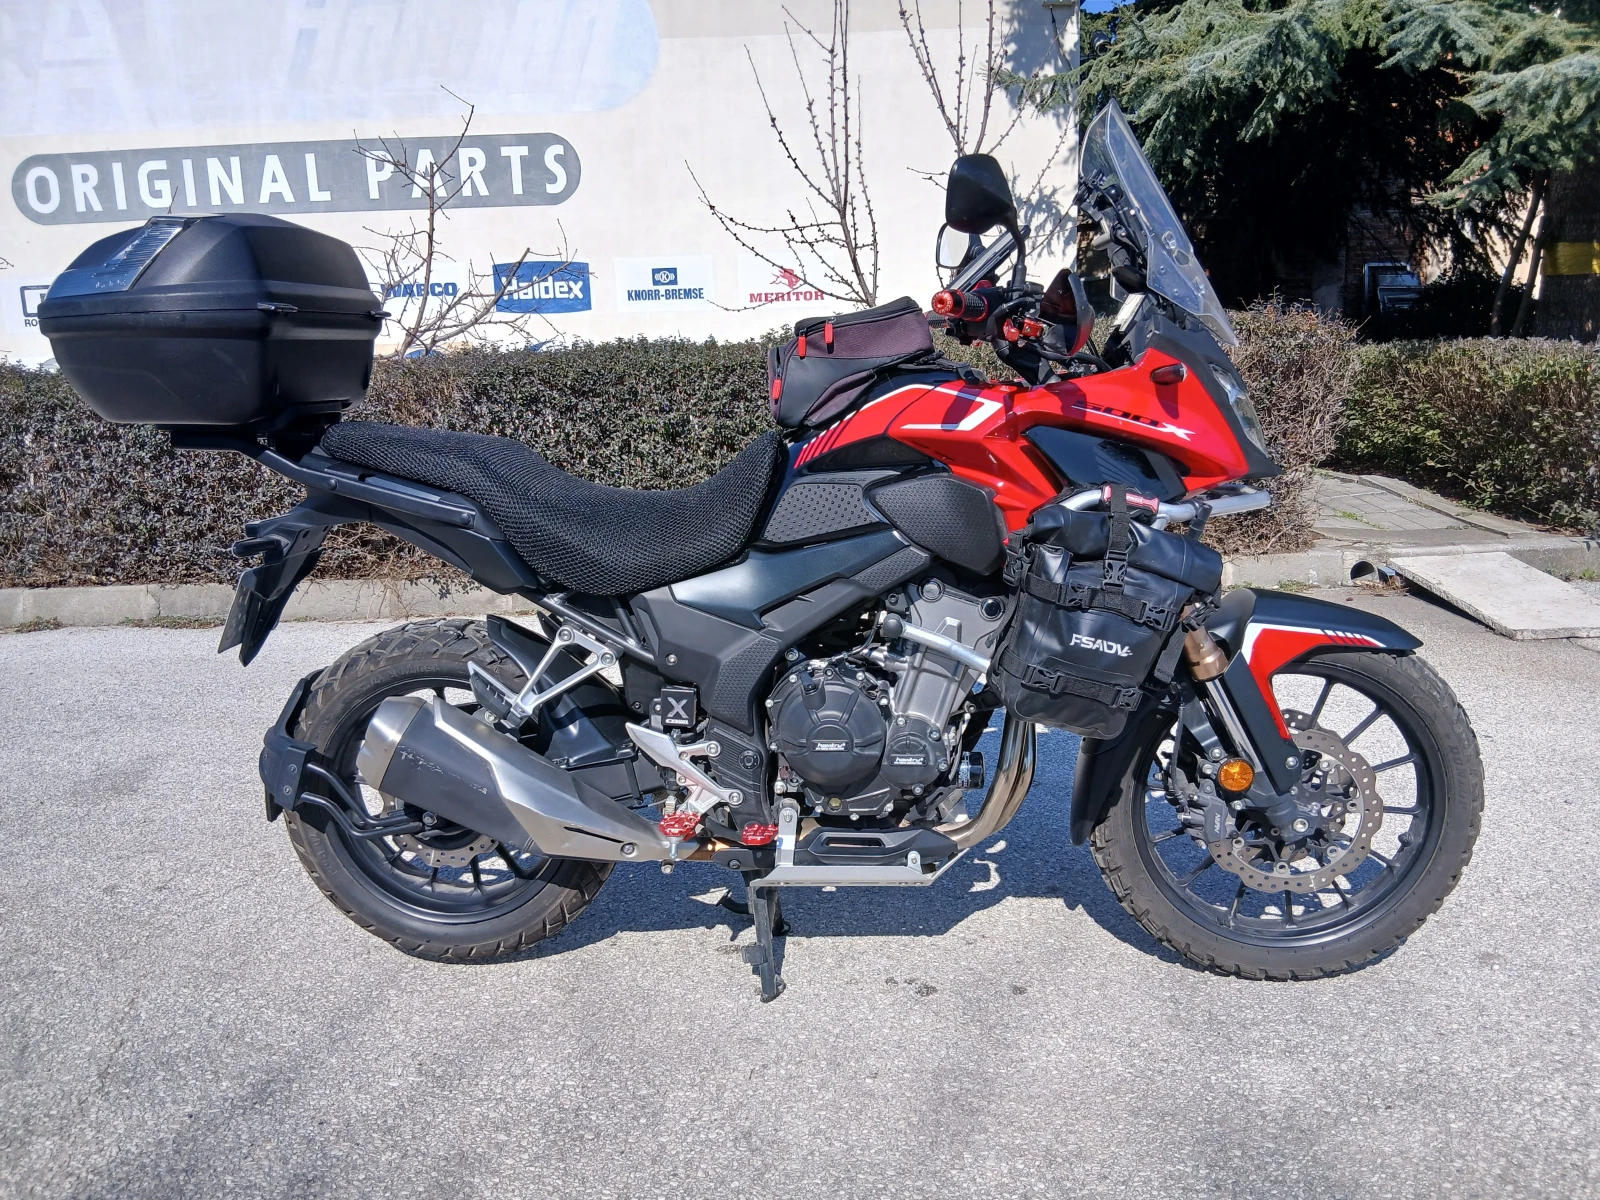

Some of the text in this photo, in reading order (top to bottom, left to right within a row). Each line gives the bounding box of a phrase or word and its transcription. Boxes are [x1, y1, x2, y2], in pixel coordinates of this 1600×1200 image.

[25, 144, 567, 214] ORIGINAL PARTS
[380, 282, 458, 298] WABCO
[501, 274, 584, 300] Haldex
[627, 287, 704, 302] KNORR-BREMSE
[749, 290, 825, 303] MERITOR
[1069, 633, 1134, 657] FSADV
